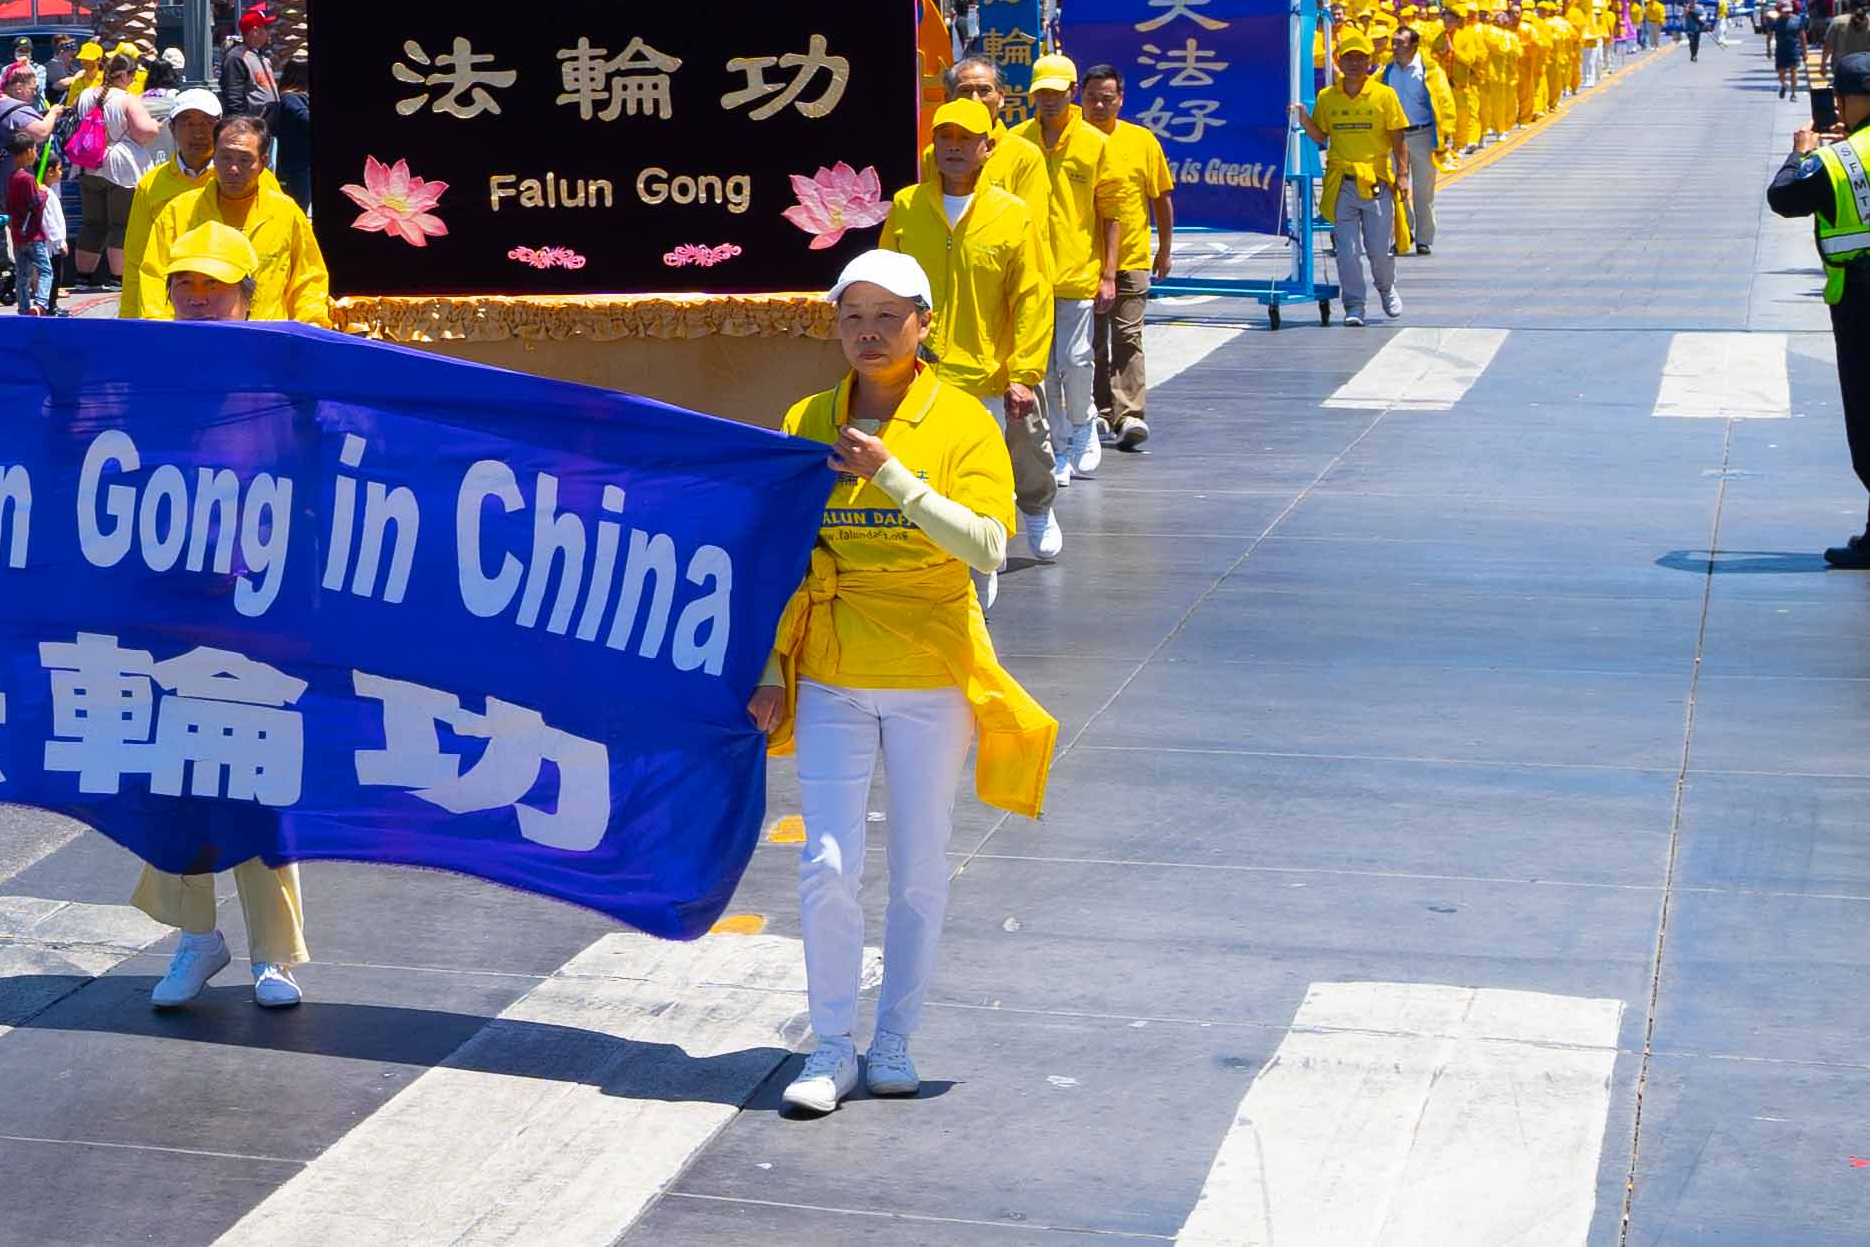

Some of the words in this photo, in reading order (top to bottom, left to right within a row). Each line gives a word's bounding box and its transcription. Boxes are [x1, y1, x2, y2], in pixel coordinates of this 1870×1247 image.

[390, 33, 851, 122] 法輪功
[489, 170, 613, 212] Falun
[636, 167, 752, 215] Gong
[1180, 157, 1202, 184] is
[1205, 157, 1277, 191] Great!
[822, 512, 867, 525] ALUN
[77, 429, 293, 617] Gong
[322, 433, 420, 604] in
[456, 459, 733, 677] China
